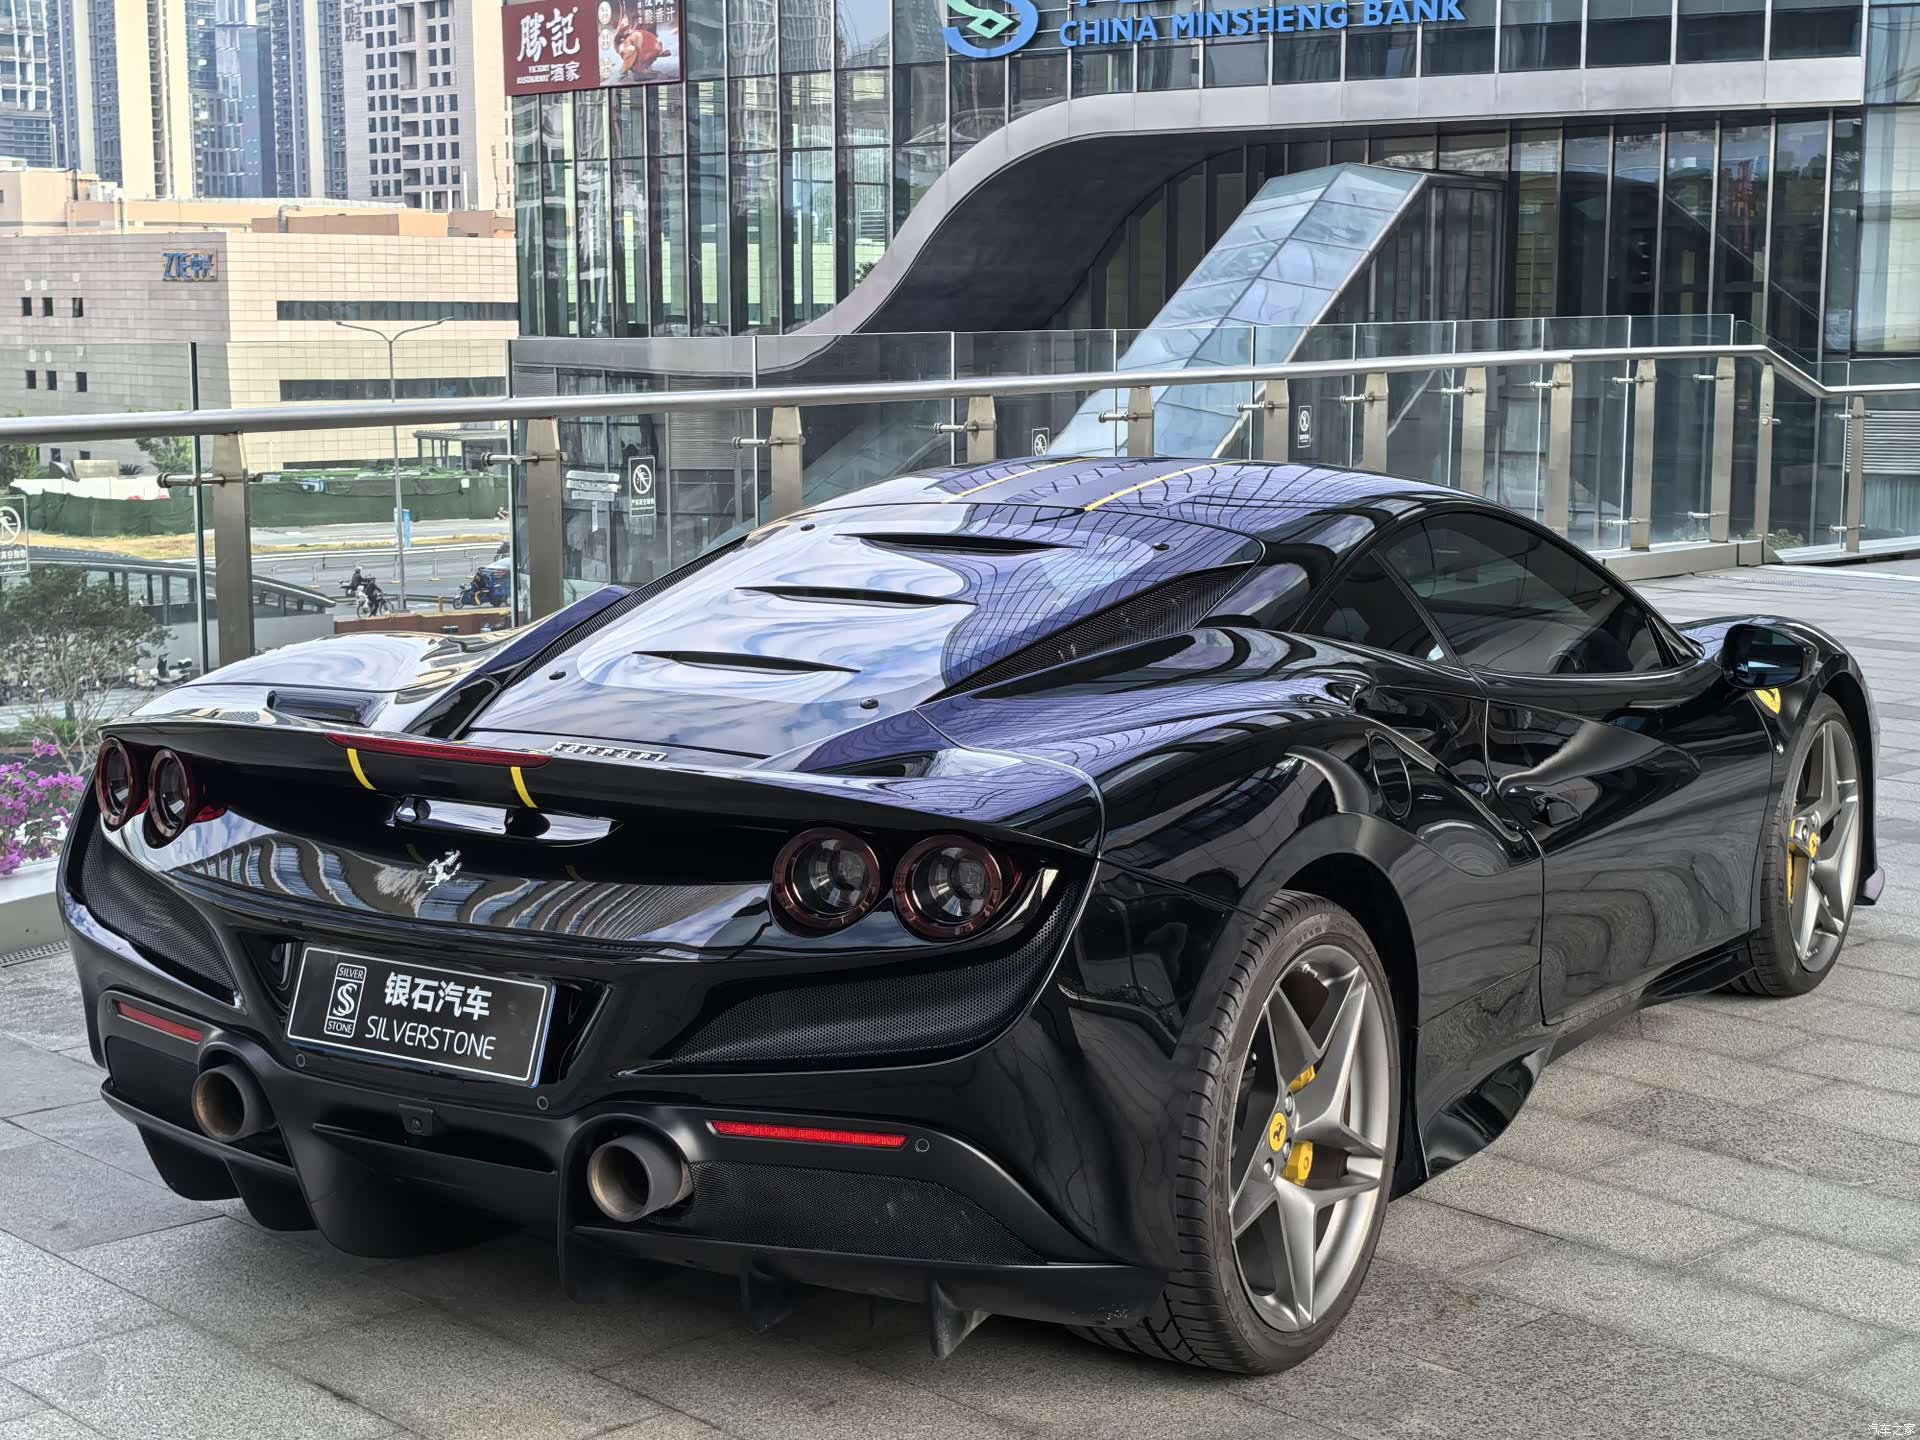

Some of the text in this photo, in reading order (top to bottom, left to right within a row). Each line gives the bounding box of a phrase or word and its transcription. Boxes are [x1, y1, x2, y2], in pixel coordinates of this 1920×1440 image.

[517, 6, 581, 62] 勝記
[1060, 0, 1466, 47] CHINA MINSHENG BANK
[550, 61, 581, 82] 酒家
[338, 967, 364, 980] SILVER
[384, 971, 493, 1021] 银石汽车
[327, 1020, 353, 1034] STONE
[365, 1014, 497, 1061] SILVERSTONE
